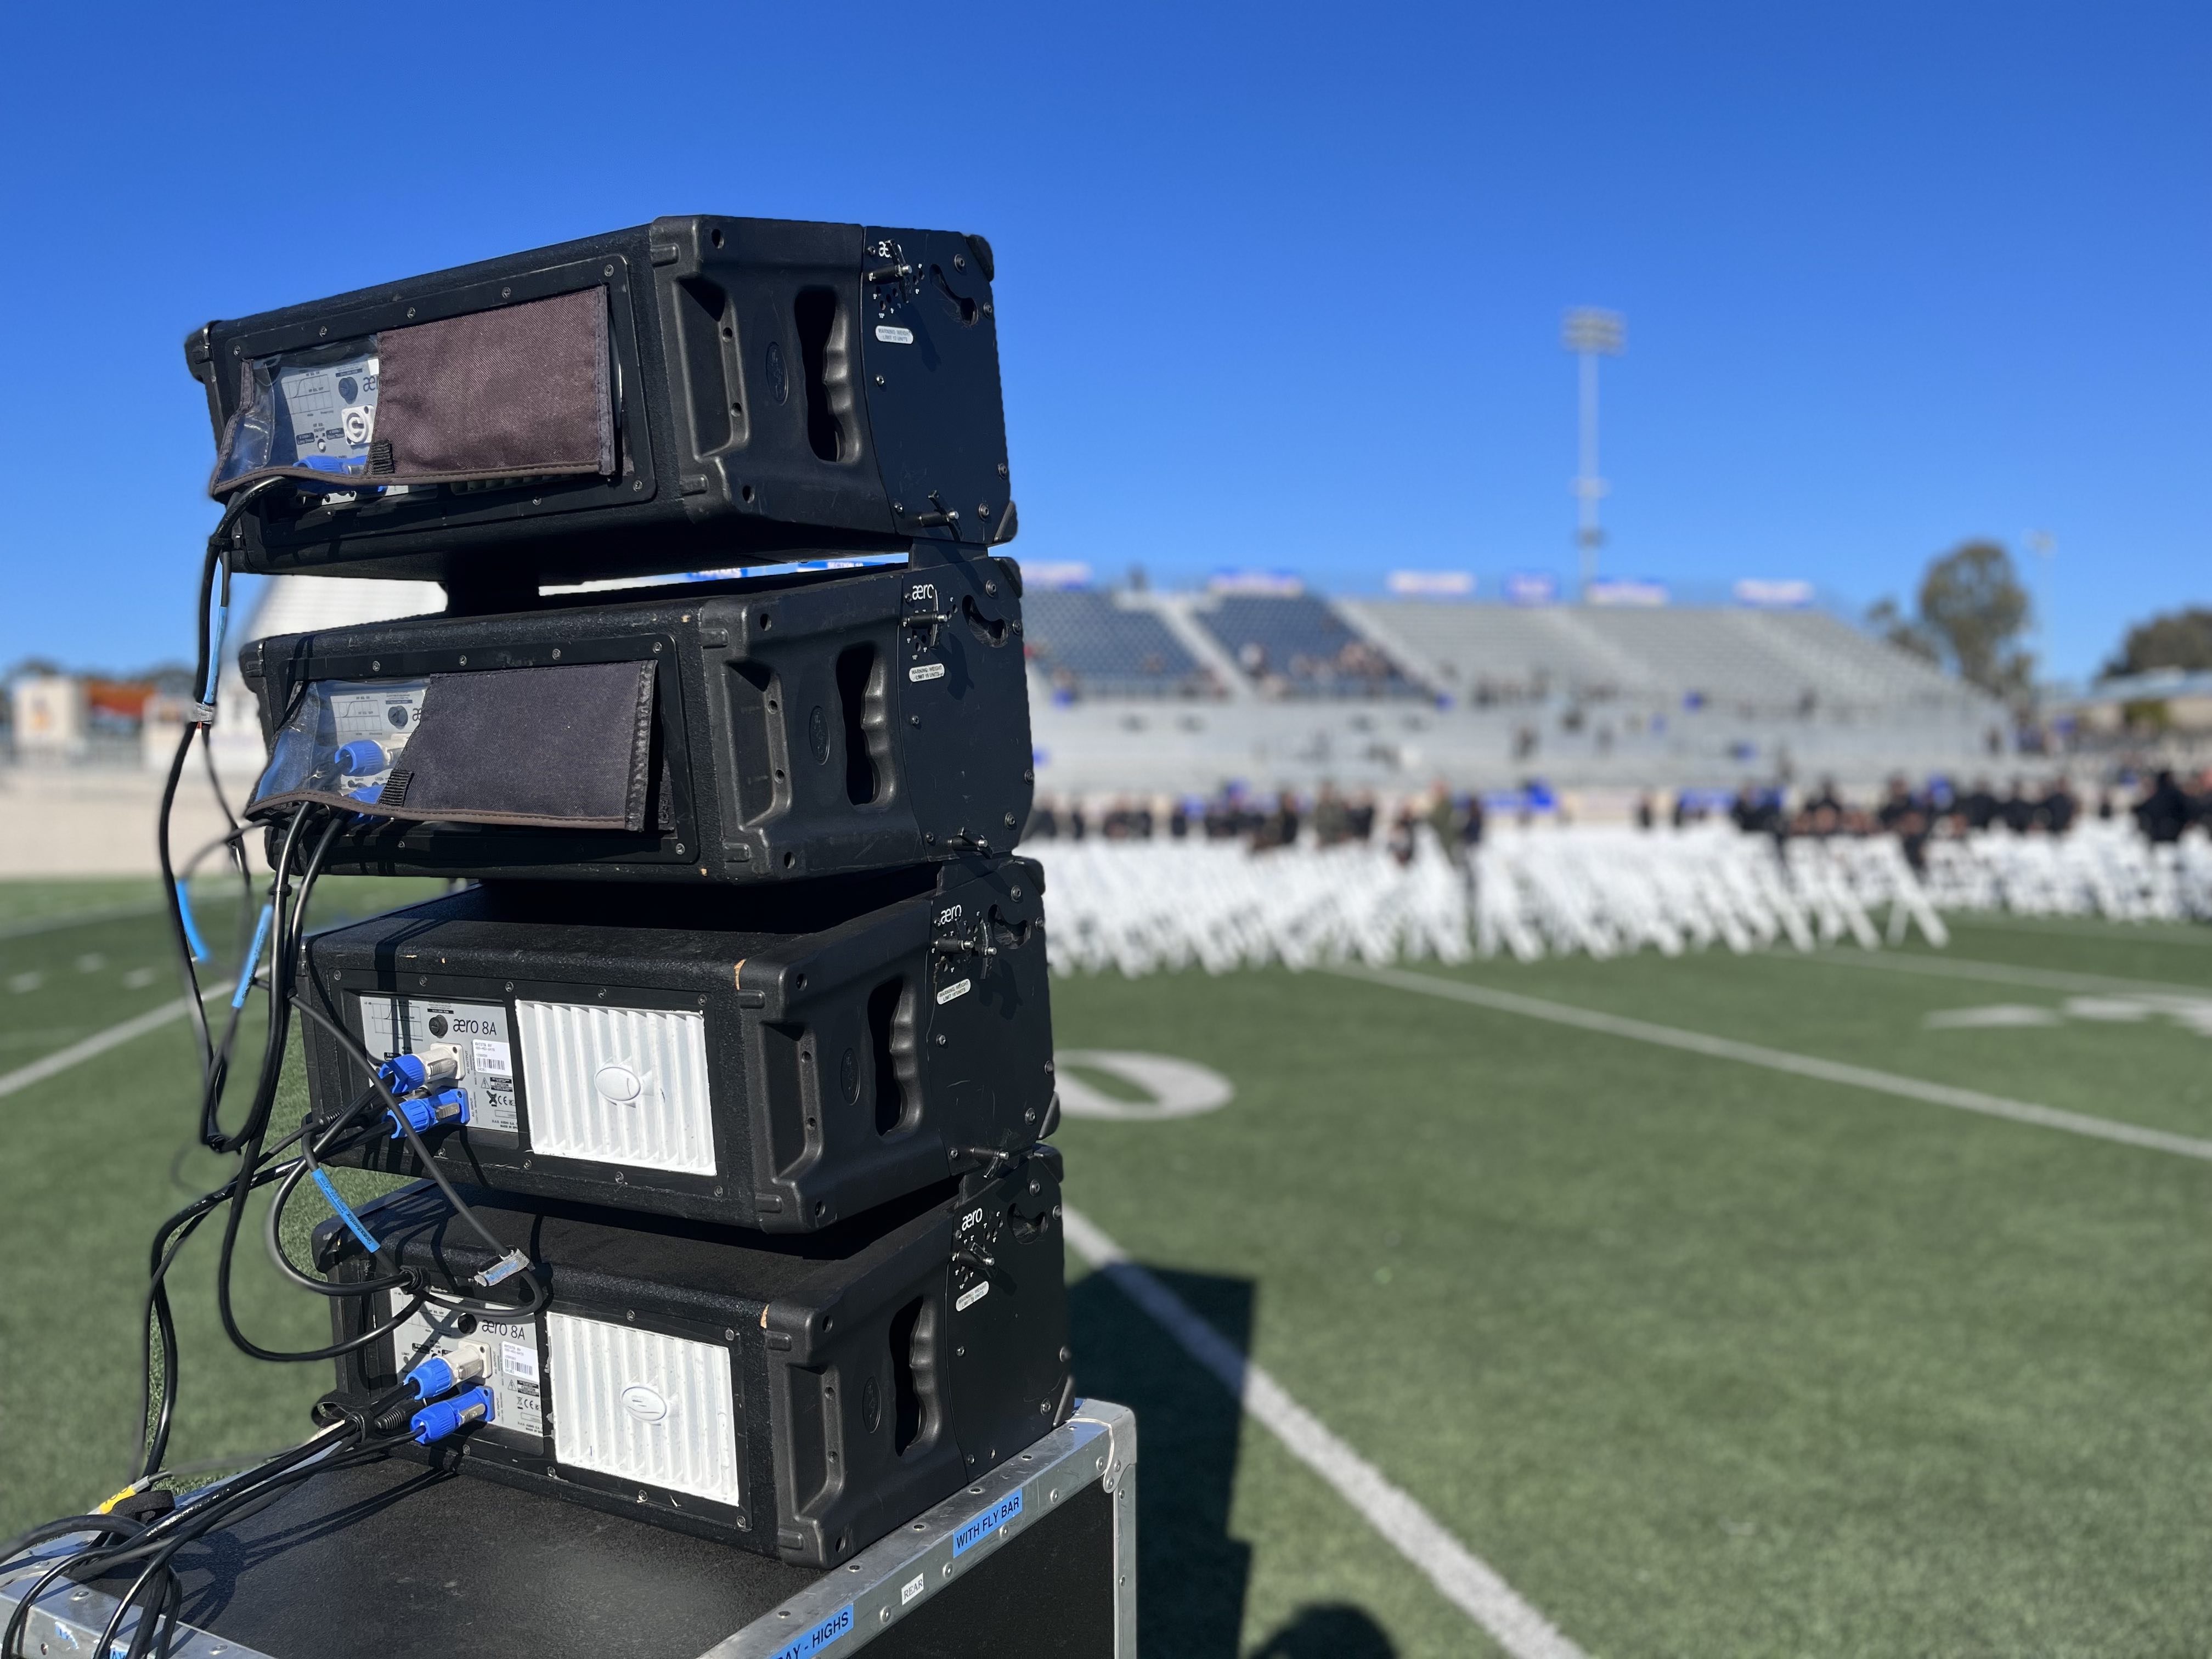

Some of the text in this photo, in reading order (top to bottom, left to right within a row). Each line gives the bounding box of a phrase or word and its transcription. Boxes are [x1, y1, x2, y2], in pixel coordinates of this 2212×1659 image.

[482, 1021, 496, 1035] 8A
[346, 1211, 373, 1245] Sweetwater
[511, 1325, 525, 1340] 8A
[956, 1497, 1019, 1549] WITH FLY BAR
[904, 1579, 923, 1600] REAR
[812, 1611, 849, 1648] HIGHS
